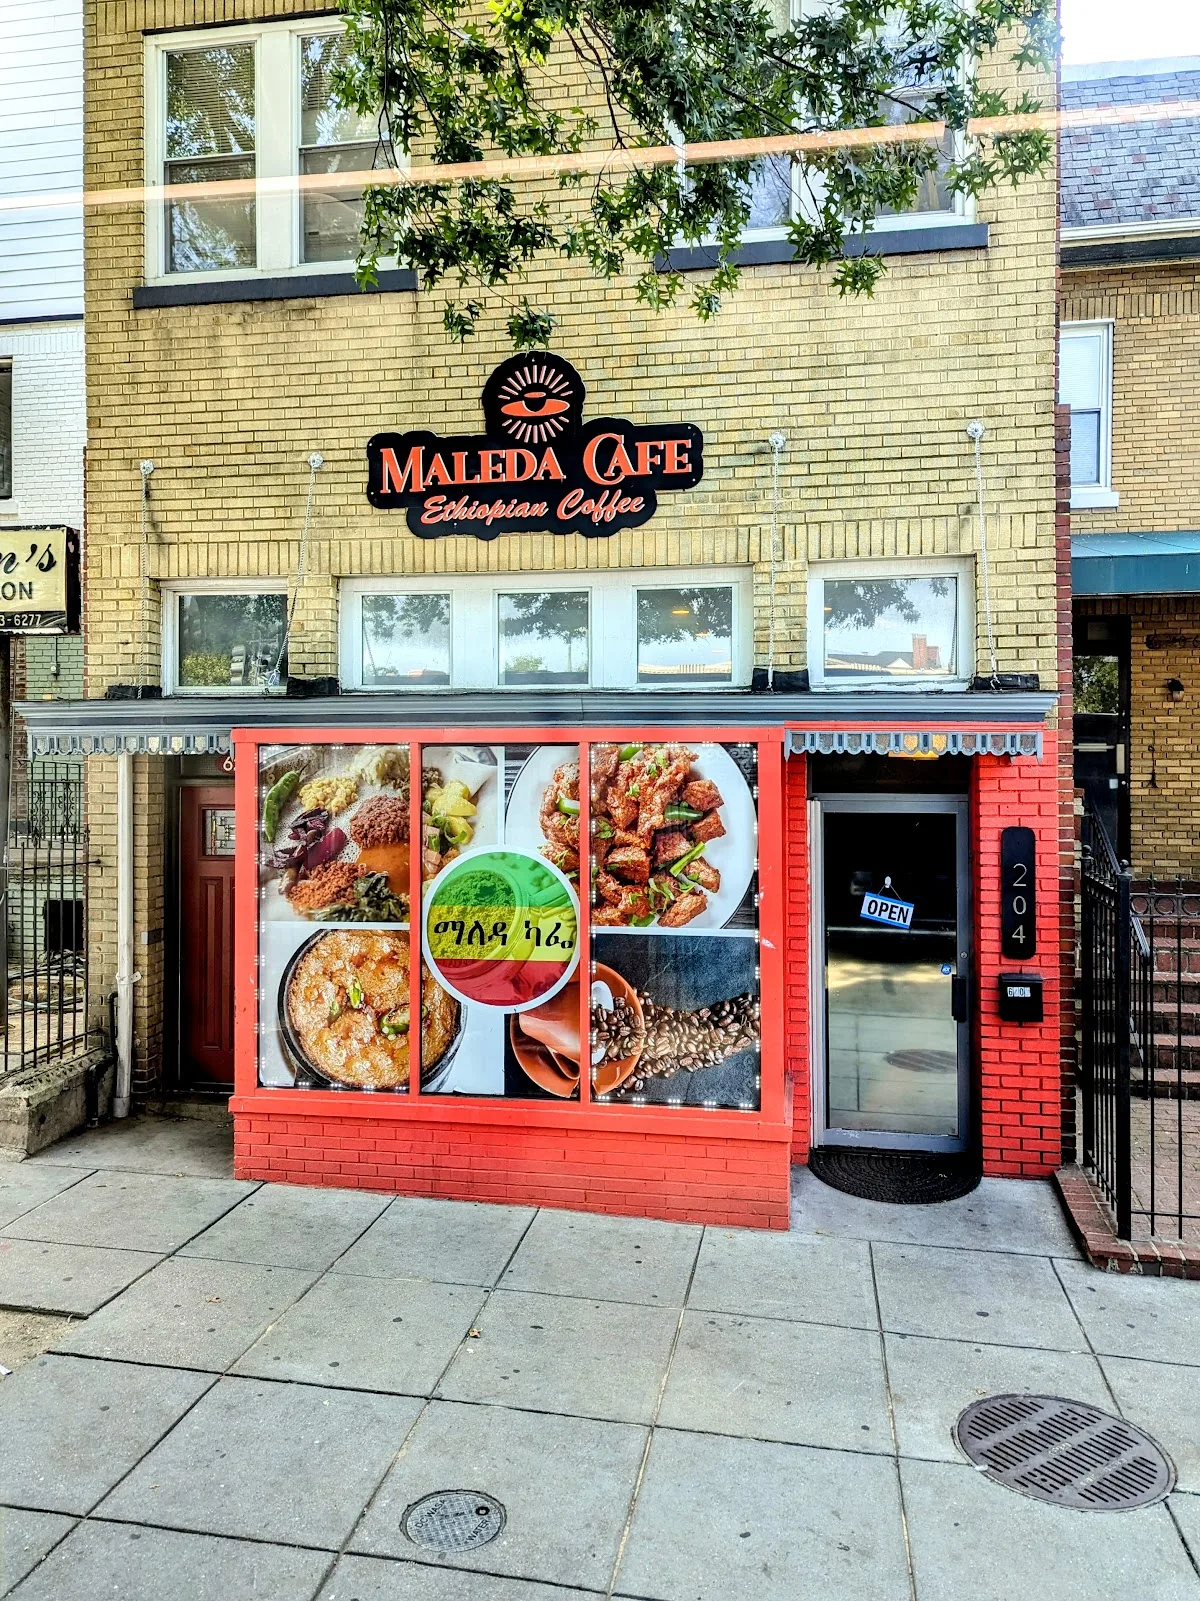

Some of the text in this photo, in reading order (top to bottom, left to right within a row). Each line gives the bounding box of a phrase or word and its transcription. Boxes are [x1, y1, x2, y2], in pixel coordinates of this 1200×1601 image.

[380, 432, 693, 494] MALEDA CAFE
[420, 488, 645, 526] Ethiopian Coffee
[1, 582, 32, 600] ON
[222, 756, 236, 771] 6
[868, 900, 909, 923] OPEN
[1011, 863, 1027, 944] 204
[433, 919, 574, 949] ማለዳ ካፌ
[466, 1519, 490, 1542] WATER
